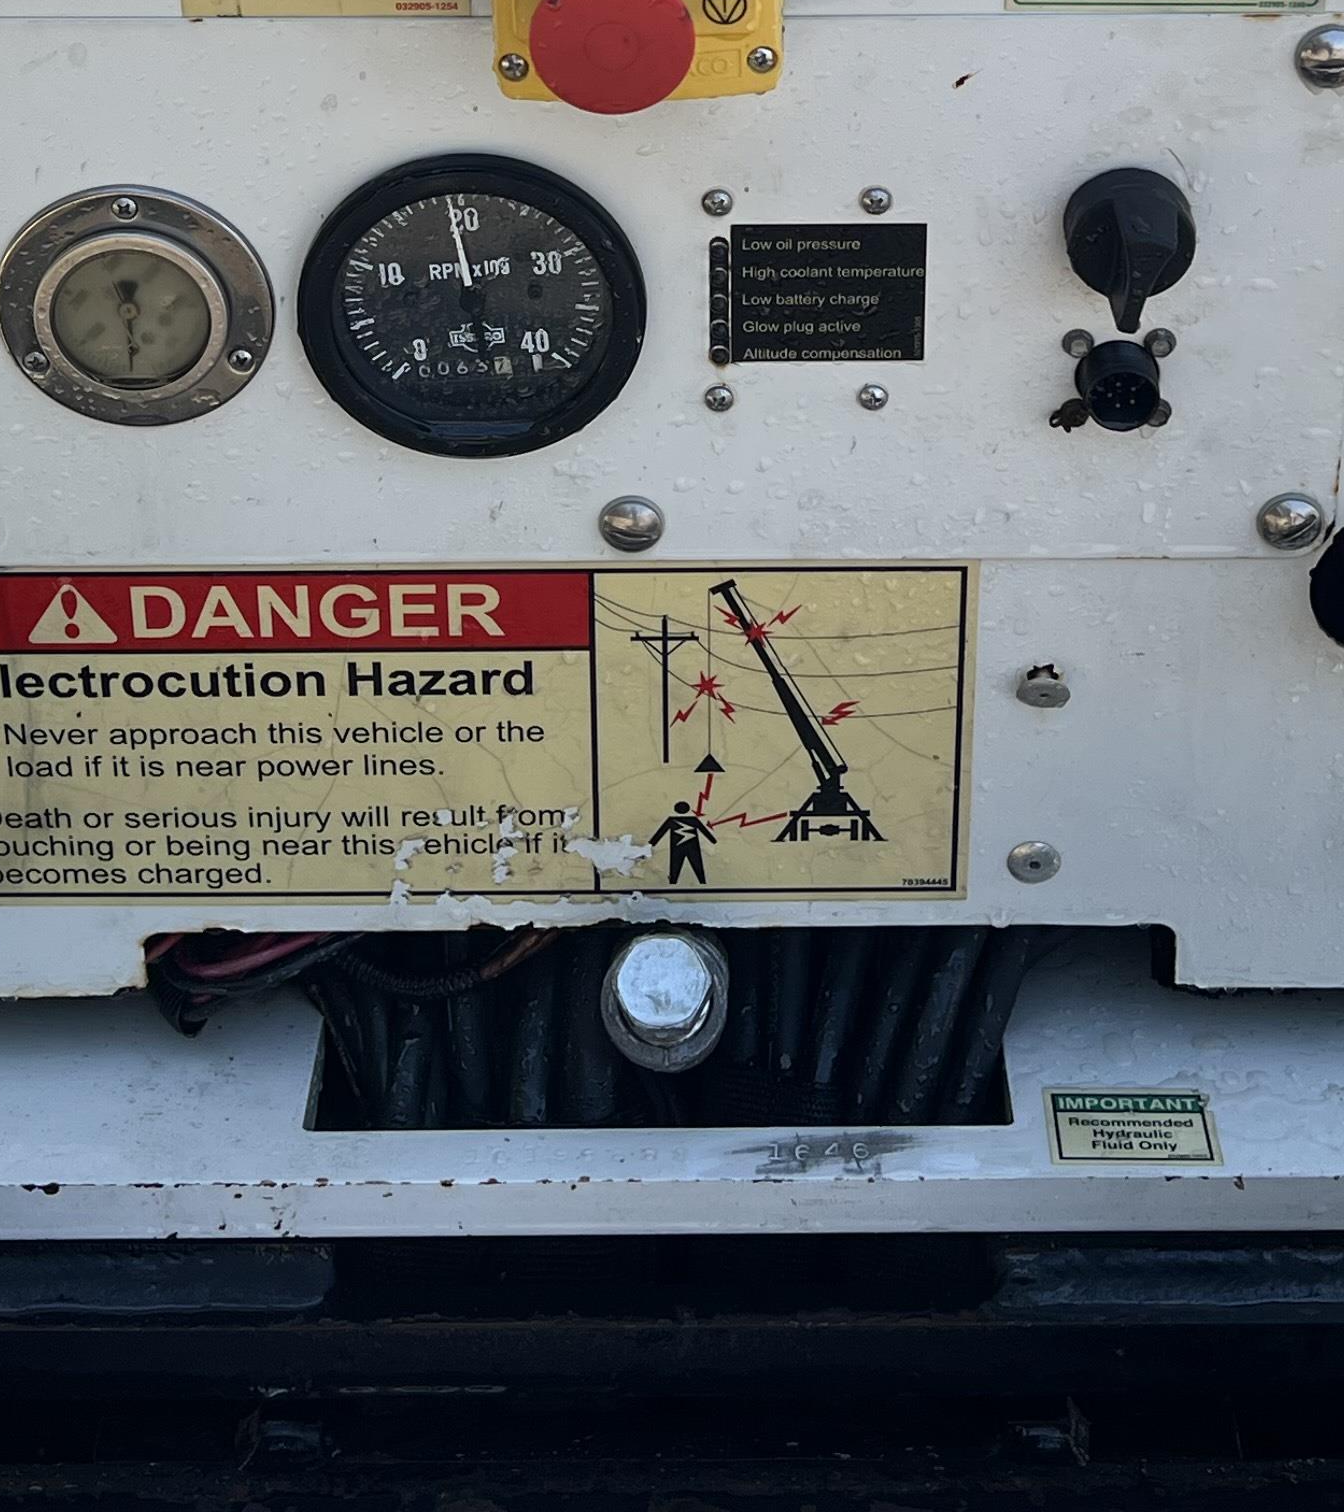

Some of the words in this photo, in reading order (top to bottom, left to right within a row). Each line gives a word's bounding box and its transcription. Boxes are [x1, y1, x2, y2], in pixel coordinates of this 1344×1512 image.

[741, 238, 772, 250] Low
[775, 238, 792, 250] oil
[797, 240, 860, 252] pressure
[531, 251, 561, 275] 30
[742, 266, 775, 280] High
[779, 266, 832, 277] coolant
[836, 265, 924, 279] temperature
[742, 293, 771, 305] Low
[775, 293, 825, 307] battery
[829, 293, 879, 308] charge
[520, 329, 549, 353] 40
[129, 583, 504, 638] DANGER
[347, 660, 533, 696] Hazard
[1058, 1097, 1195, 1110] IMPORTANT
[1068, 1116, 1193, 1127] Recommended
[1092, 1128, 1172, 1139] Hydraulic
[1091, 1140, 1133, 1149] Fluid
[1138, 1140, 1177, 1151] Only
